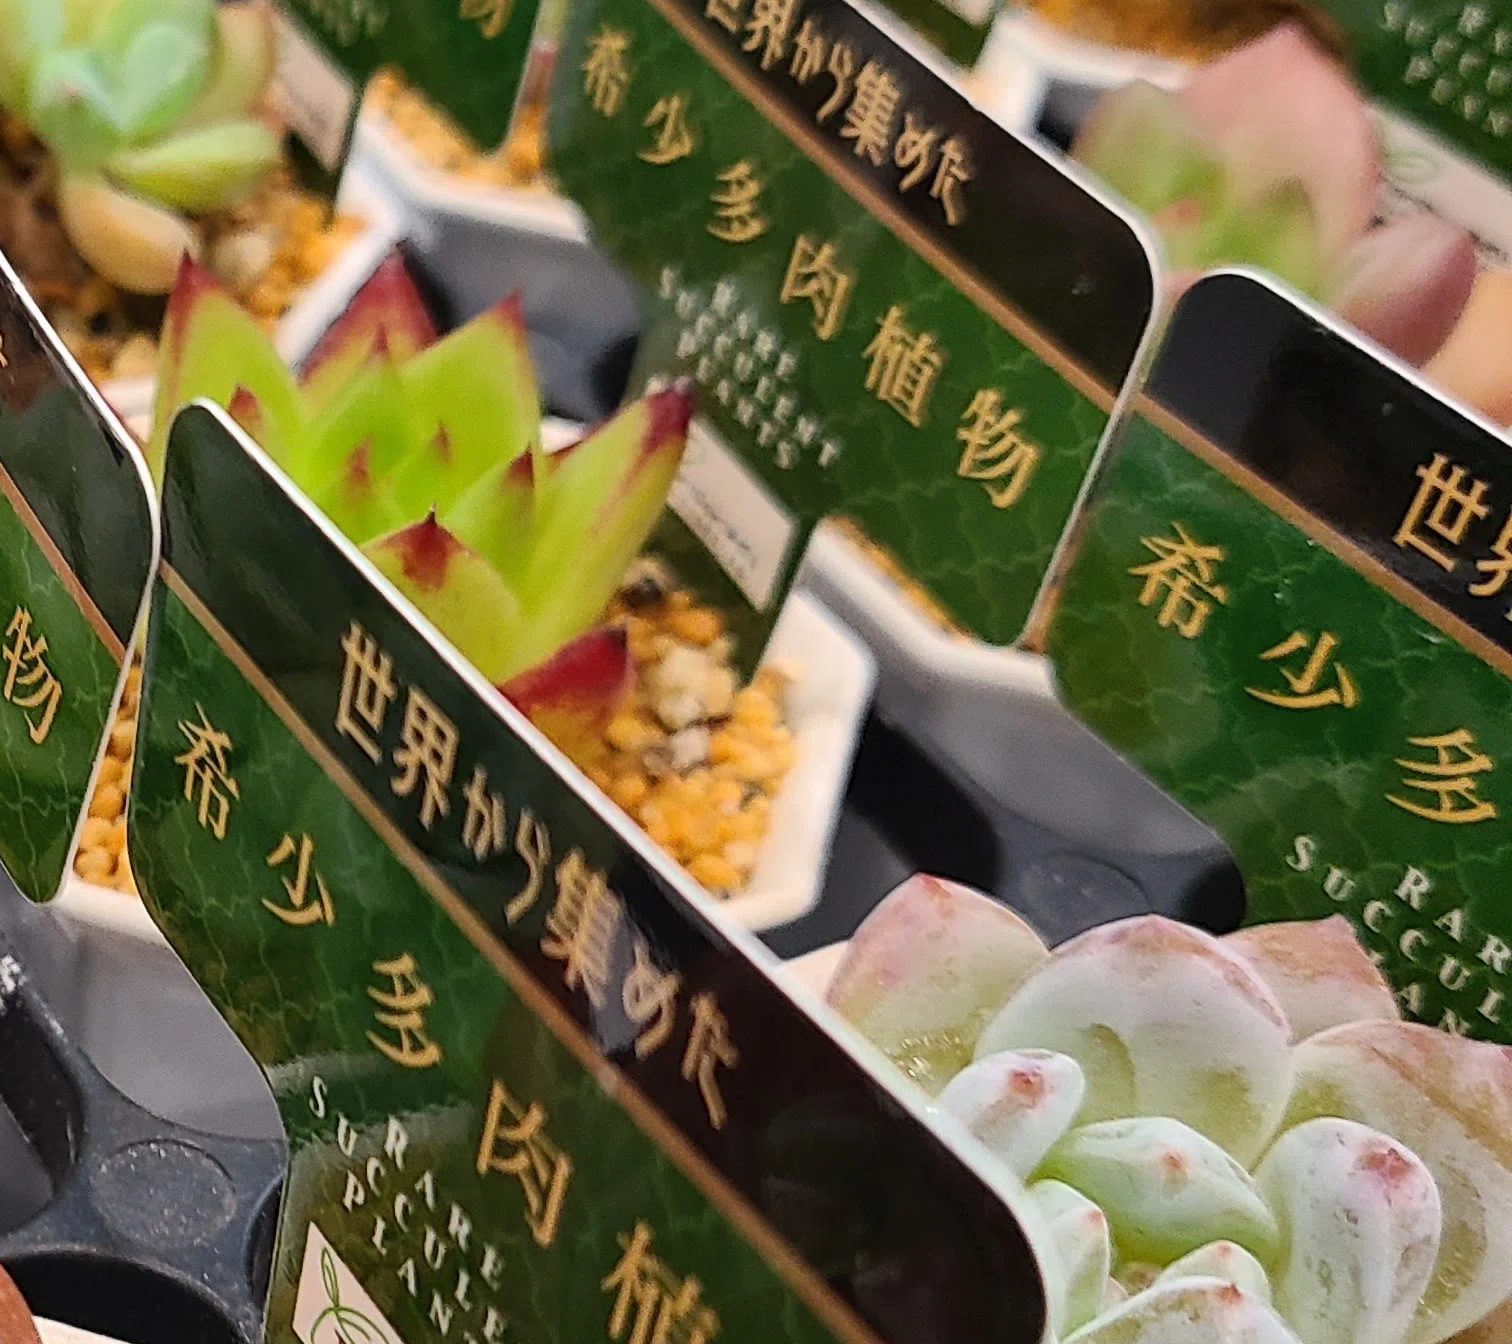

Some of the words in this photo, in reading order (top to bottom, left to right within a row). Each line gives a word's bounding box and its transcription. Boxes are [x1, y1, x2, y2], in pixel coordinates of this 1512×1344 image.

[581, 22, 1038, 510] 希少多肉植物
[1127, 520, 1497, 825] 希少多
[332, 619, 743, 1131] 世界から集めた
[384, 1114, 505, 1292] RARE
